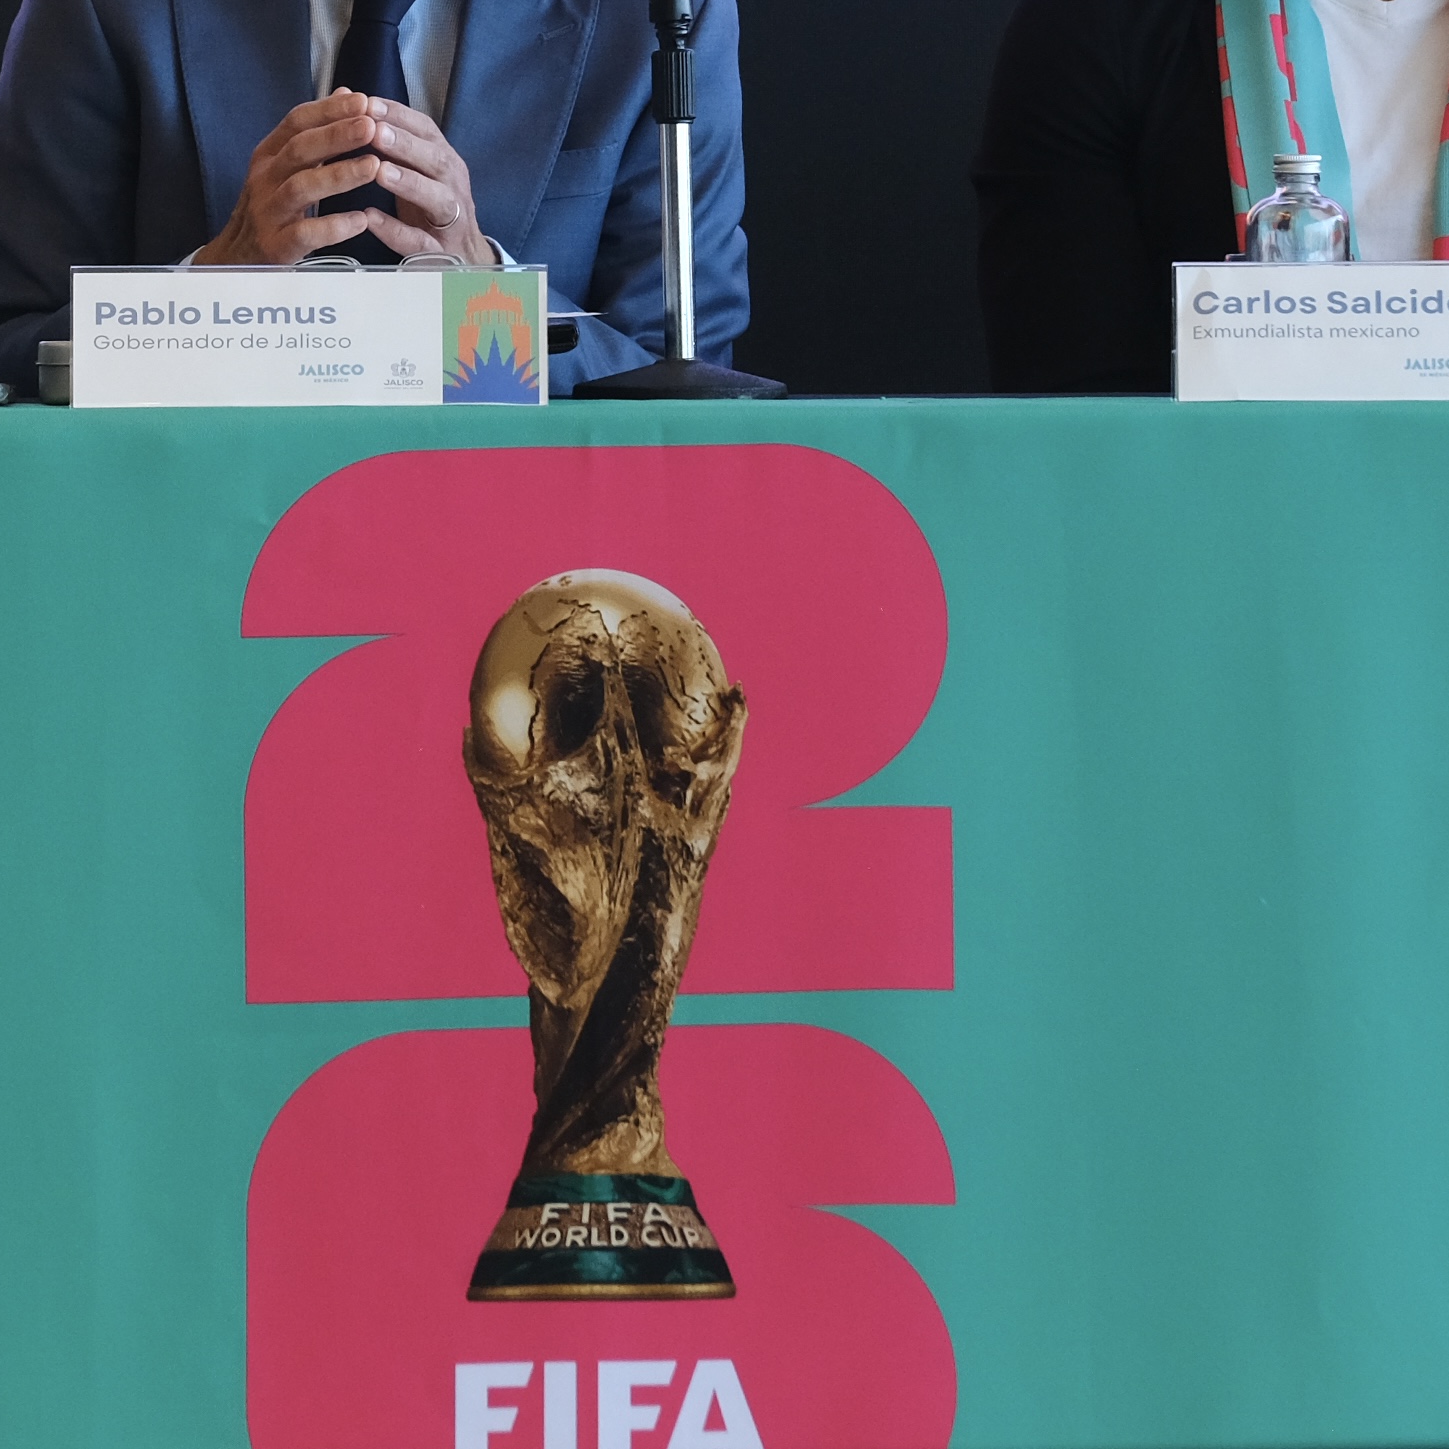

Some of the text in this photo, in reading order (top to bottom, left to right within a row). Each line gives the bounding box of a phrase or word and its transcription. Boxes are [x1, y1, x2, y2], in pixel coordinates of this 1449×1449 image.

[95, 300, 337, 326] Pablo Lemus
[1192, 289, 1317, 316] Carlos
[93, 332, 352, 350] Gobernador de Jalisco
[1192, 323, 1421, 340] Exmundialista mexicano
[298, 364, 365, 376] JALISCO
[539, 1201, 673, 1226] FIFA
[514, 1225, 702, 1249] WORLD CUP
[454, 1358, 765, 1449] FIFA
